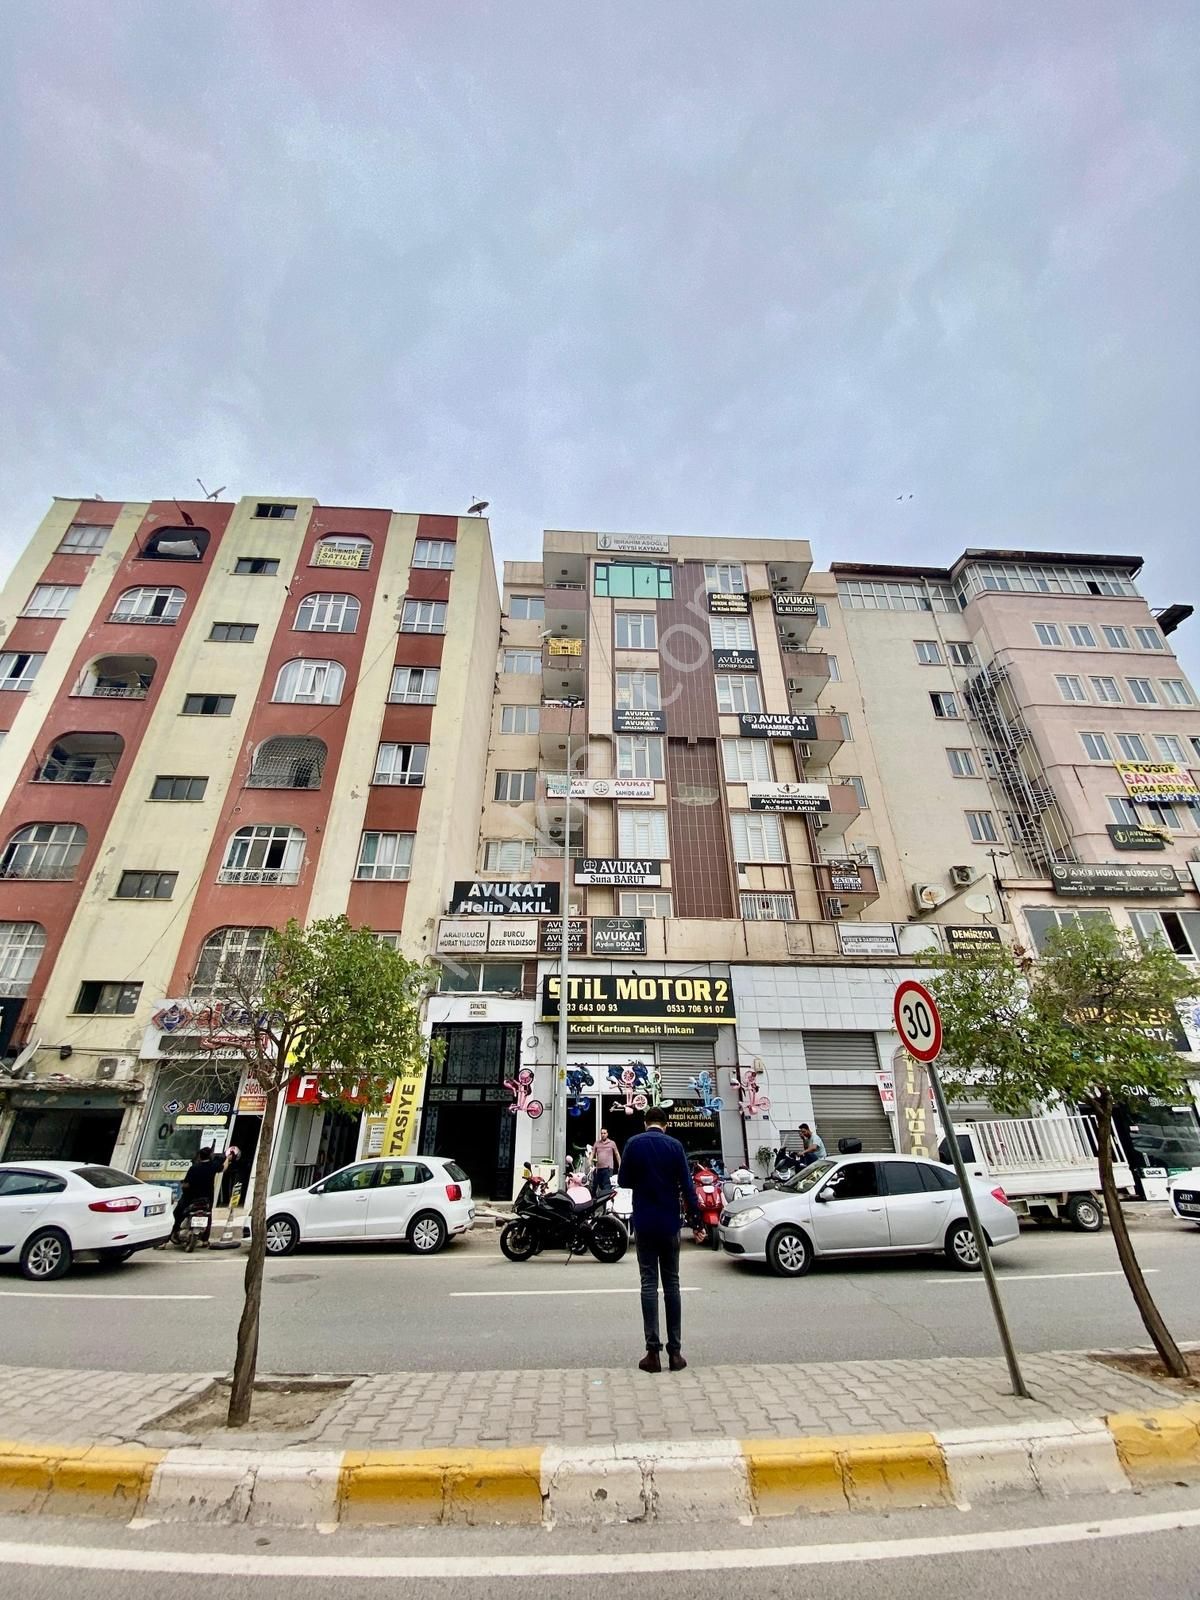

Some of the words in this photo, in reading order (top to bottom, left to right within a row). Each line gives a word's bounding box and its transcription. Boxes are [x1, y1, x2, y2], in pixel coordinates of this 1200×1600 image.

[778, 596, 813, 604] AVUKAT
[759, 714, 808, 724] AVUKAT
[1131, 786, 1156, 794] 0544
[600, 861, 652, 874] AVUKAT
[1126, 869, 1158, 878] BÜROSU
[590, 874, 612, 884] Suna
[614, 876, 646, 884] BARUT
[468, 884, 546, 896] AVUKAT
[460, 901, 504, 912] Helin
[508, 902, 551, 912] AKIL
[595, 932, 642, 940] AVUKAT
[952, 929, 994, 939] DEMİRKOL
[616, 978, 710, 1001] MOTOR
[715, 981, 728, 1002] 2
[578, 1004, 594, 1012] 643
[596, 1004, 606, 1012] 00
[608, 1004, 618, 1012] 93
[666, 1004, 686, 1013] 0533
[688, 1005, 702, 1013] 706
[716, 1006, 724, 1014] 07
[903, 1001, 931, 1040] 30
[570, 1024, 595, 1033] Kredi
[598, 1024, 631, 1033] Kartına
[634, 1025, 662, 1034] Taksit
[664, 1024, 695, 1034] İmkanı
[187, 1099, 231, 1115] alkaya
